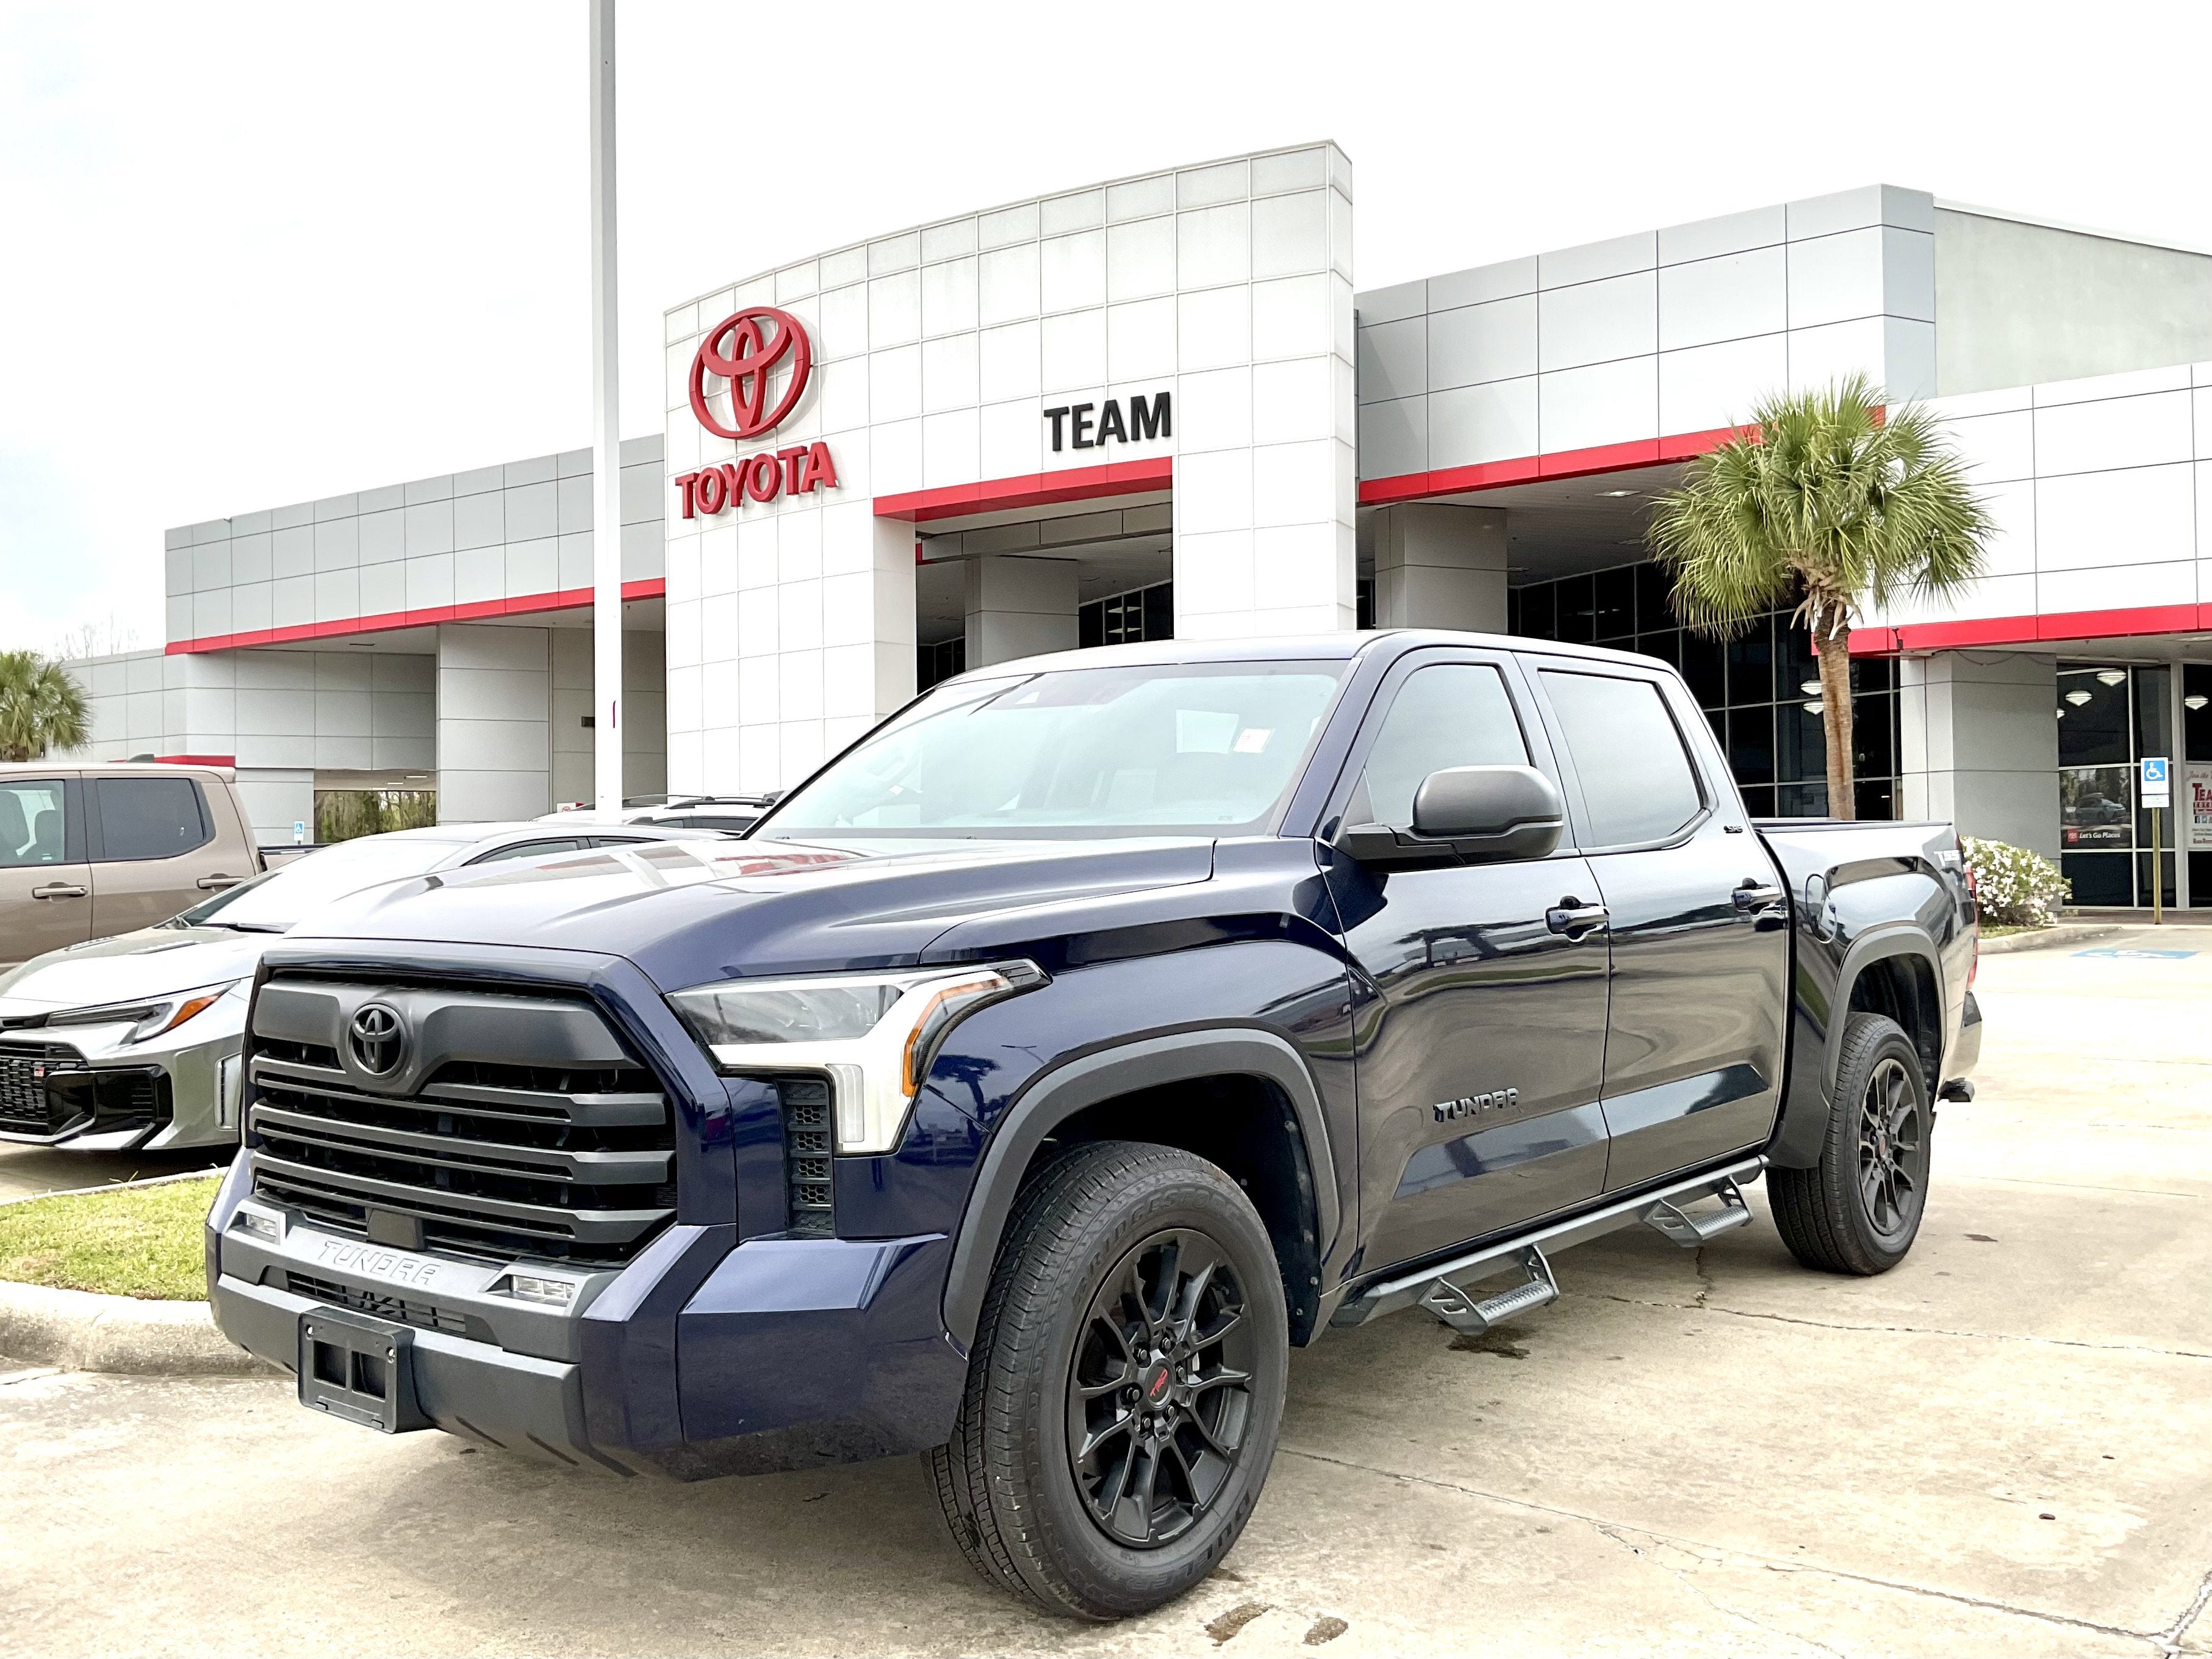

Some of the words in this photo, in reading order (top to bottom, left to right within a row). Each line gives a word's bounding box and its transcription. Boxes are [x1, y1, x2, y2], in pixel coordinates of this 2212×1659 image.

[1044, 391, 1172, 452] TEAM
[675, 441, 838, 519] TOYOTA
[1433, 1087, 1520, 1123] TUNDRA
[317, 1240, 442, 1286] TUNDRA
